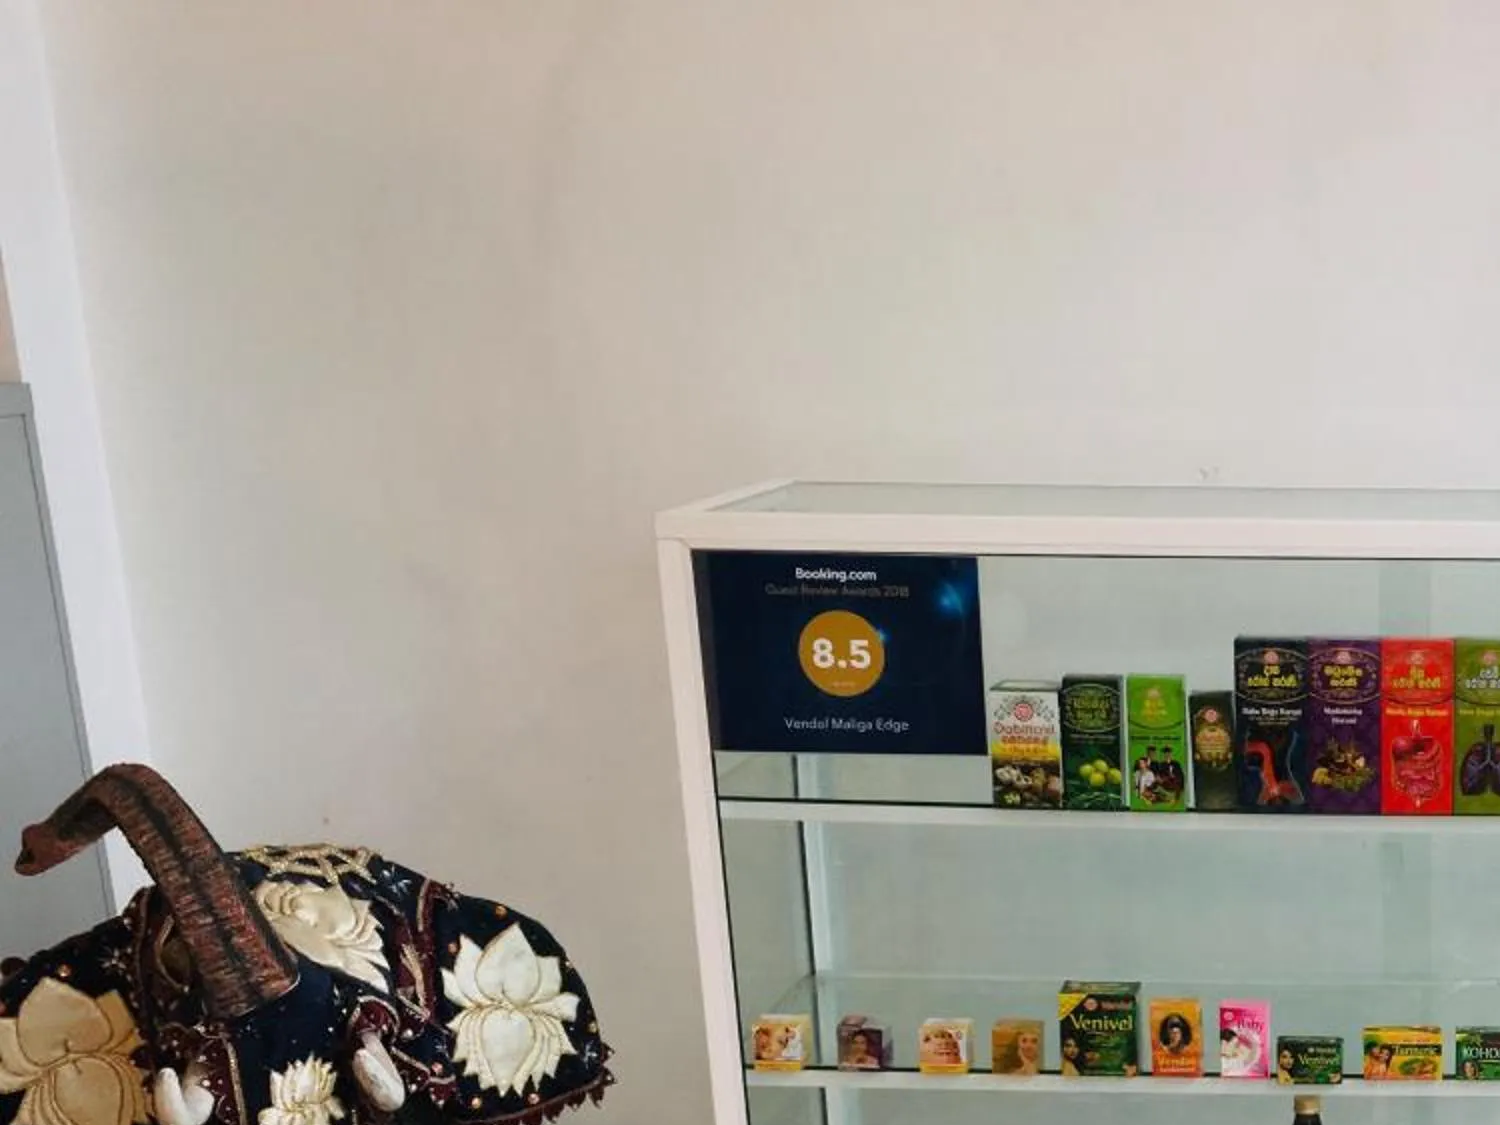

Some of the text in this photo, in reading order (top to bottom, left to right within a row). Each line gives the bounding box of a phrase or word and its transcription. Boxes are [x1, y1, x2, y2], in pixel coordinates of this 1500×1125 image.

[795, 567, 877, 582] Booking.com
[812, 637, 871, 669] 8.5
[875, 718, 910, 733] Edge
[1070, 1013, 1134, 1031] Venivel
[1297, 1053, 1341, 1067] Venivel
